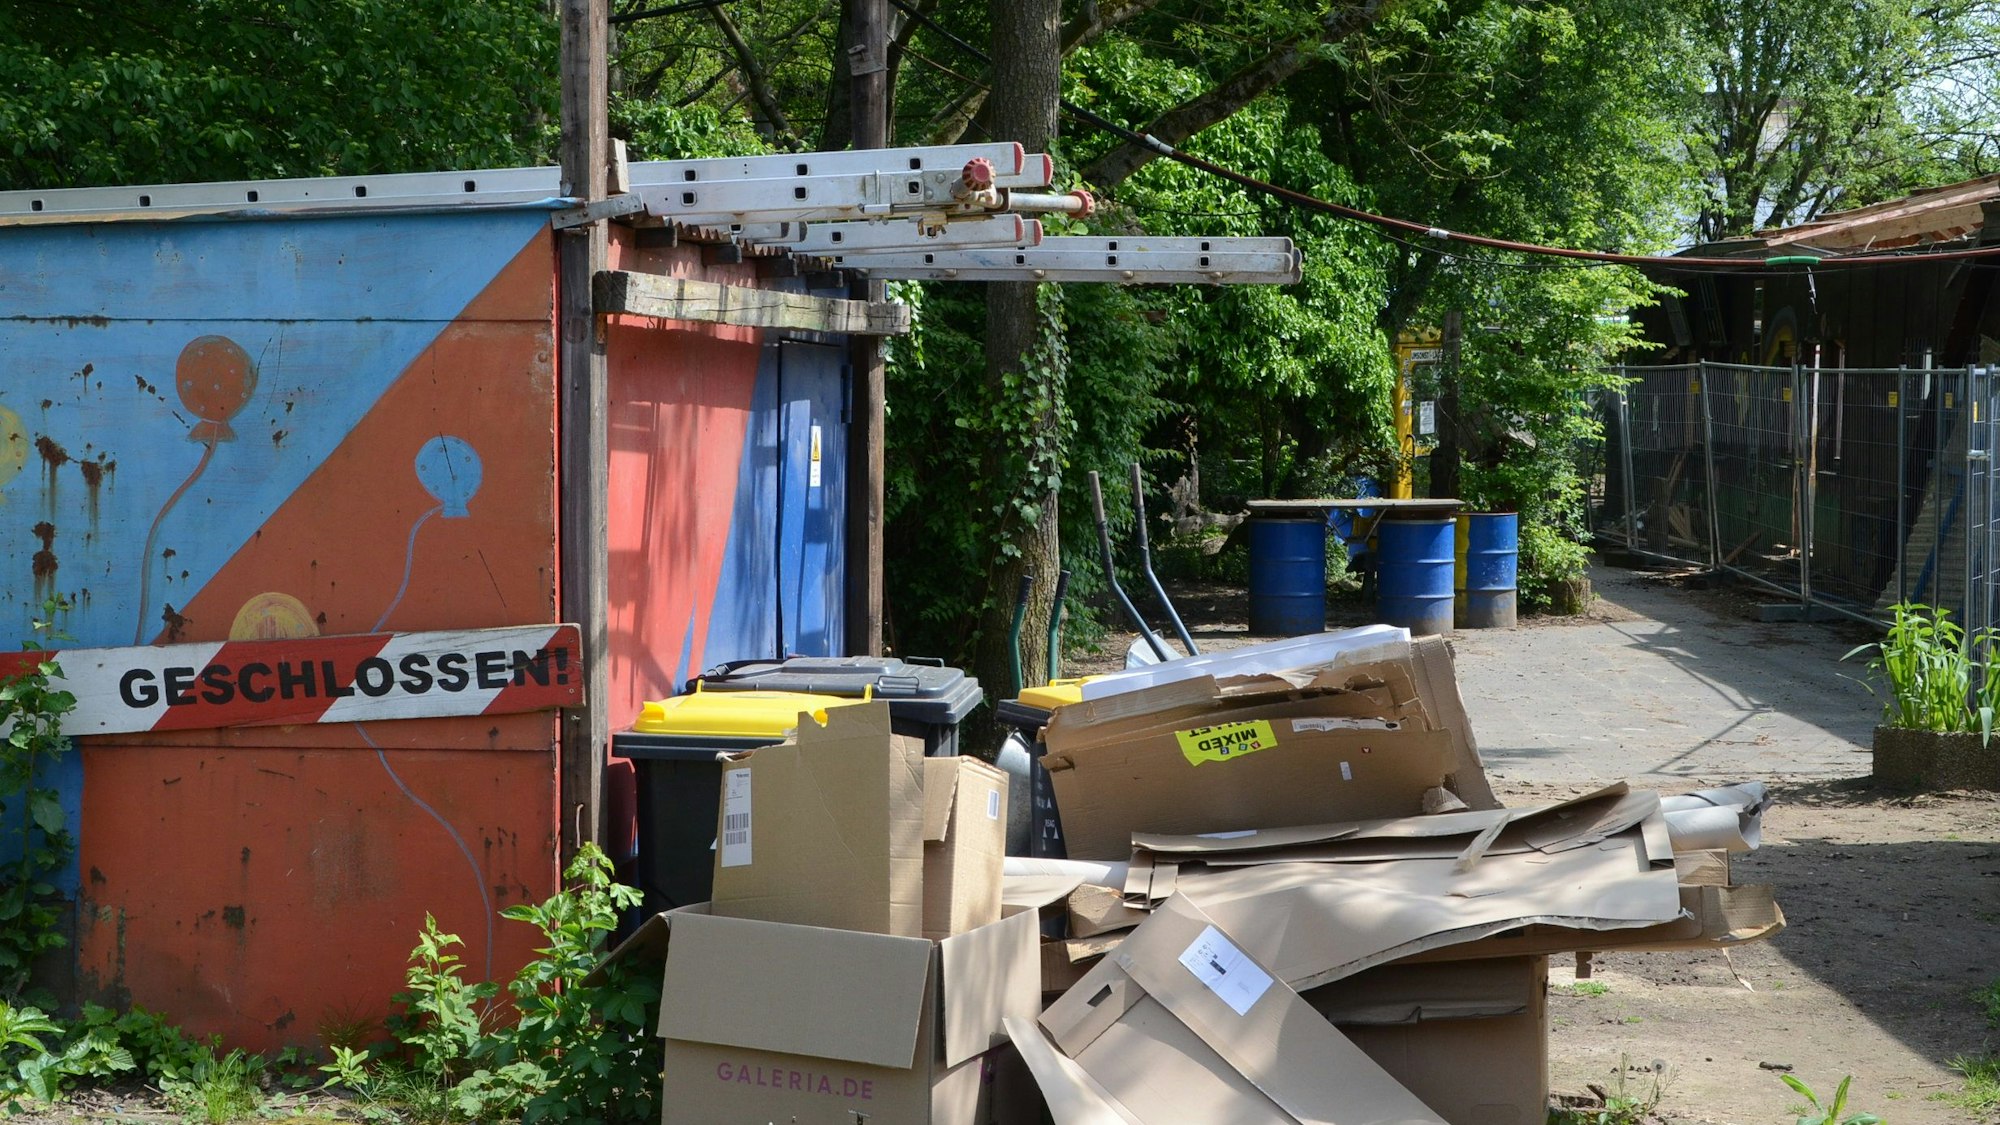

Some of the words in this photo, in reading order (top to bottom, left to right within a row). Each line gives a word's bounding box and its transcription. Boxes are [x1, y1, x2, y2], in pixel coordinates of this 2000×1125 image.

[119, 647, 569, 709] GESCHLOSSEN!
[1198, 728, 1258, 751] MIXED
[716, 1062, 873, 1100] GALERIA.DE
